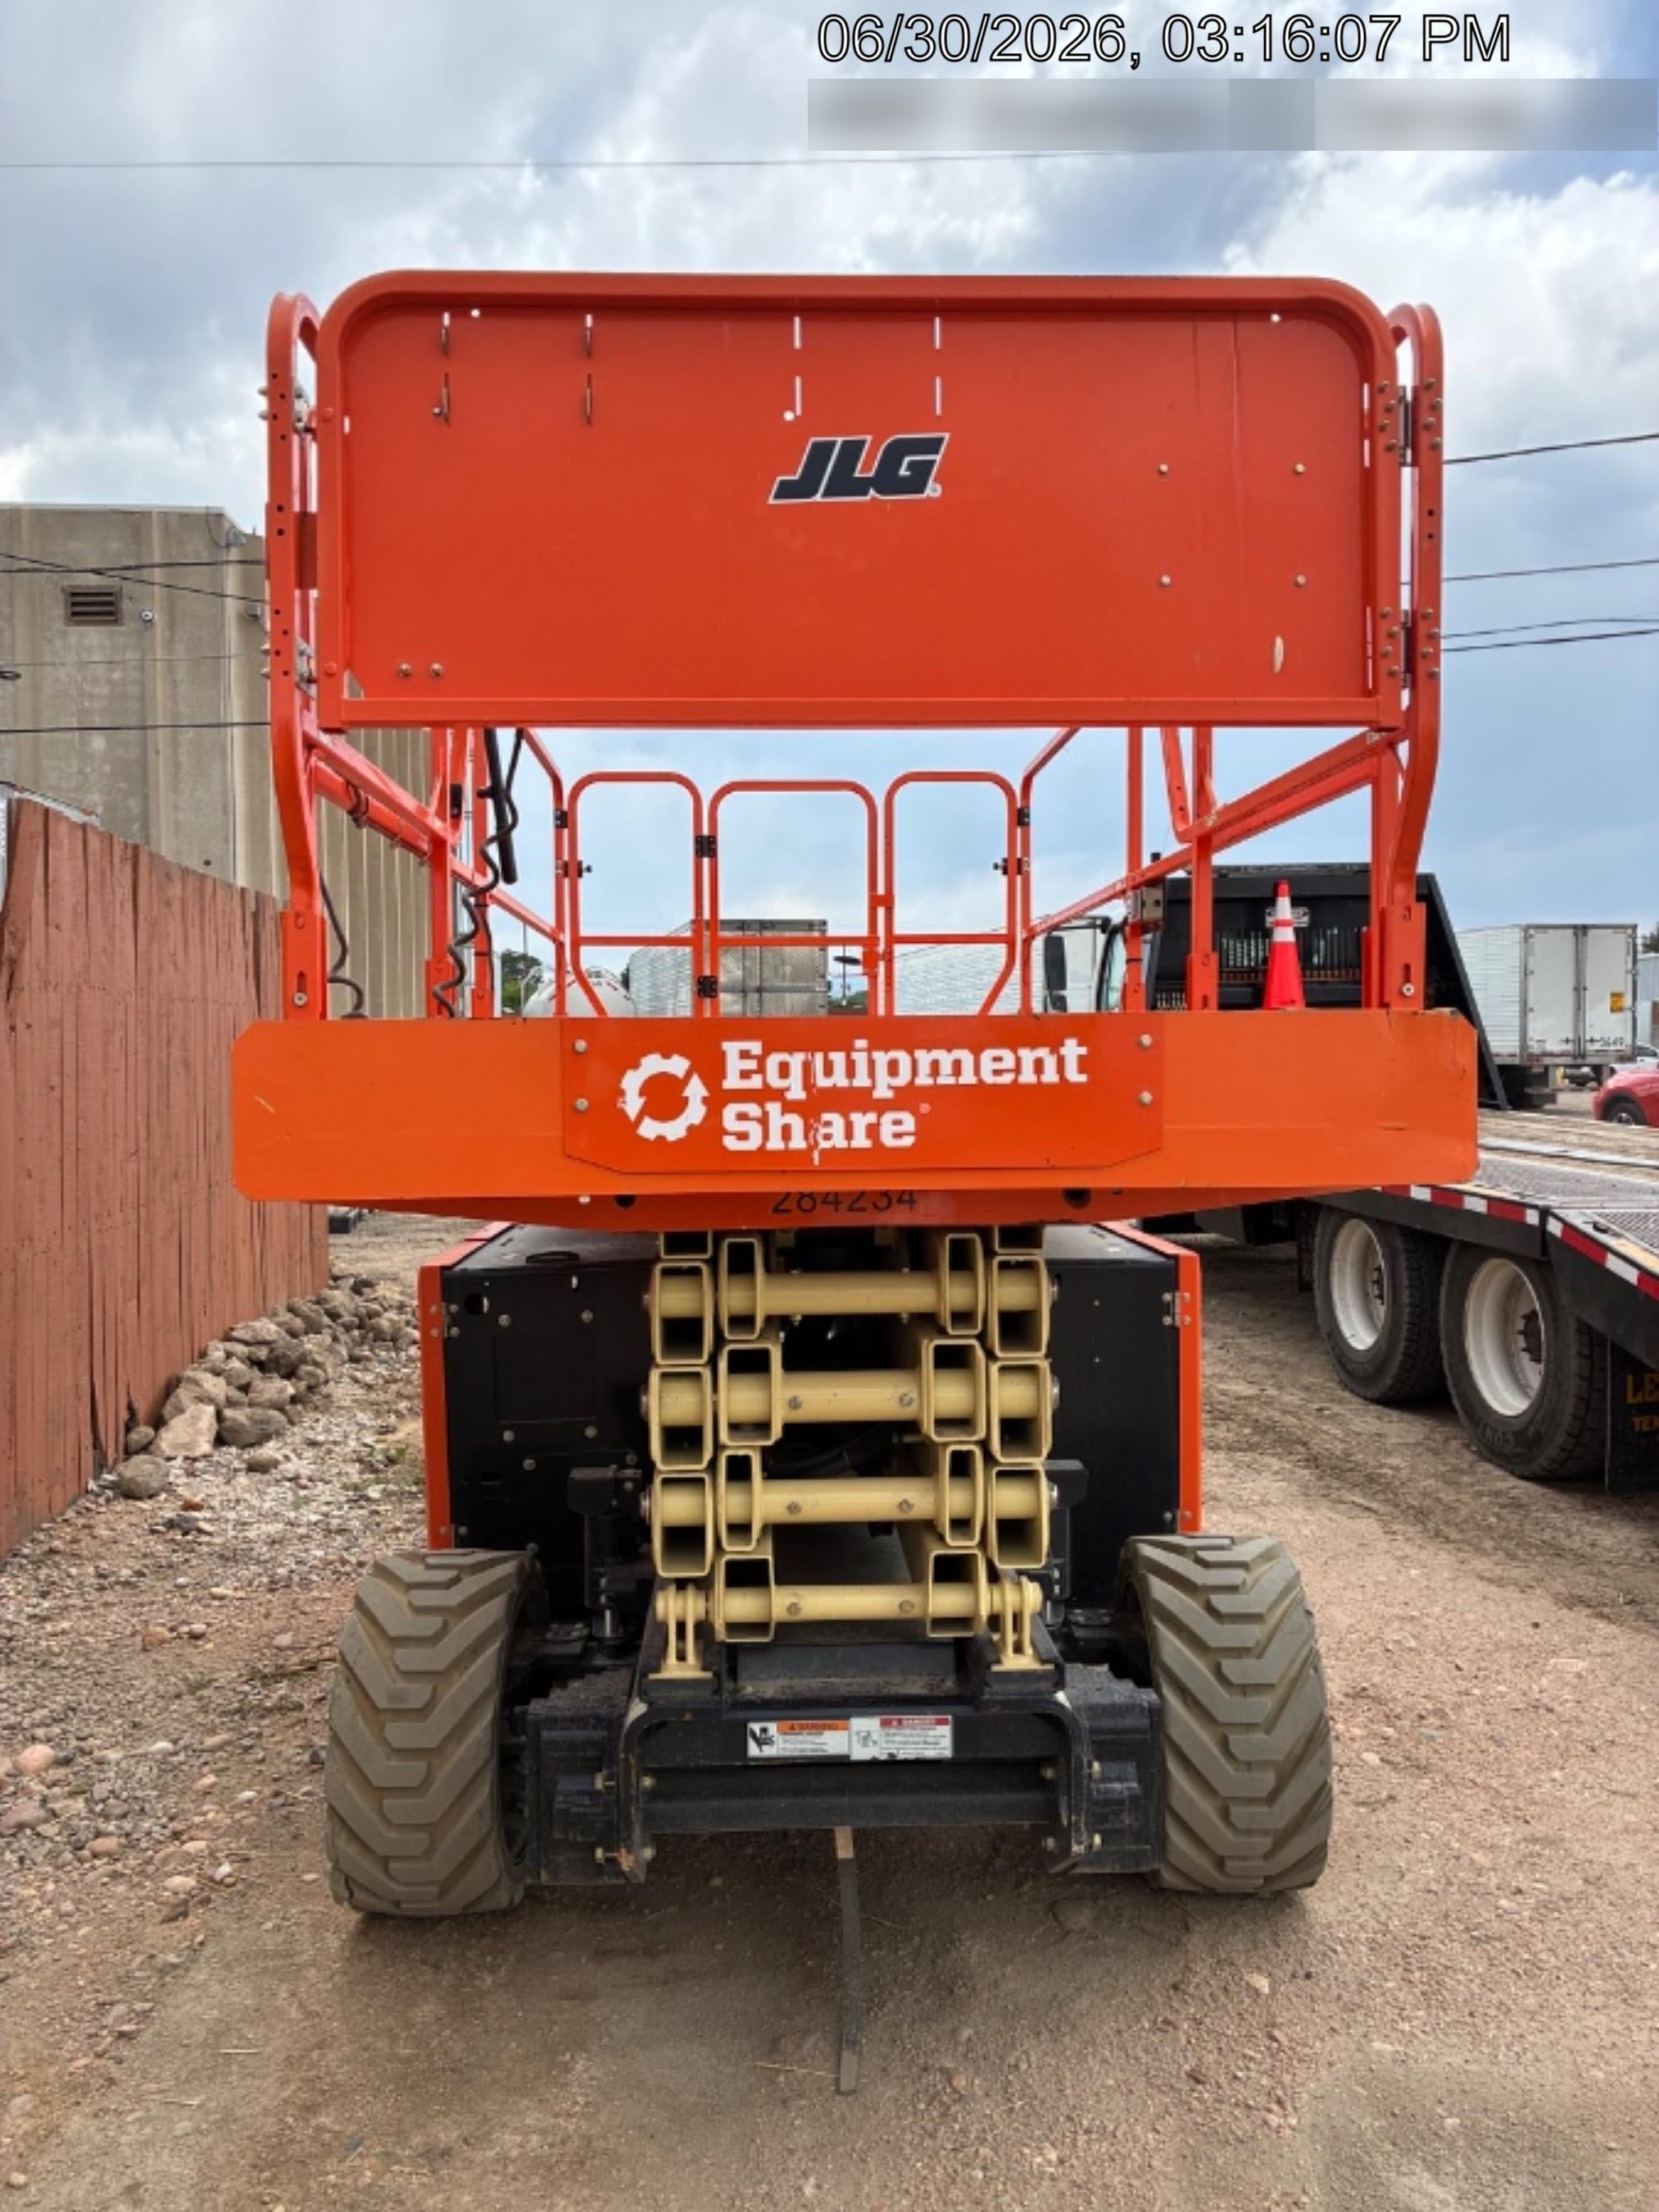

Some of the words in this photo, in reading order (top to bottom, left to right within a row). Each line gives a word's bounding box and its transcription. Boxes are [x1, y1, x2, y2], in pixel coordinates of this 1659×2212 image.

[768, 432, 951, 505] JLG
[721, 1037, 1088, 1099] Equipment
[721, 1101, 917, 1152] Share
